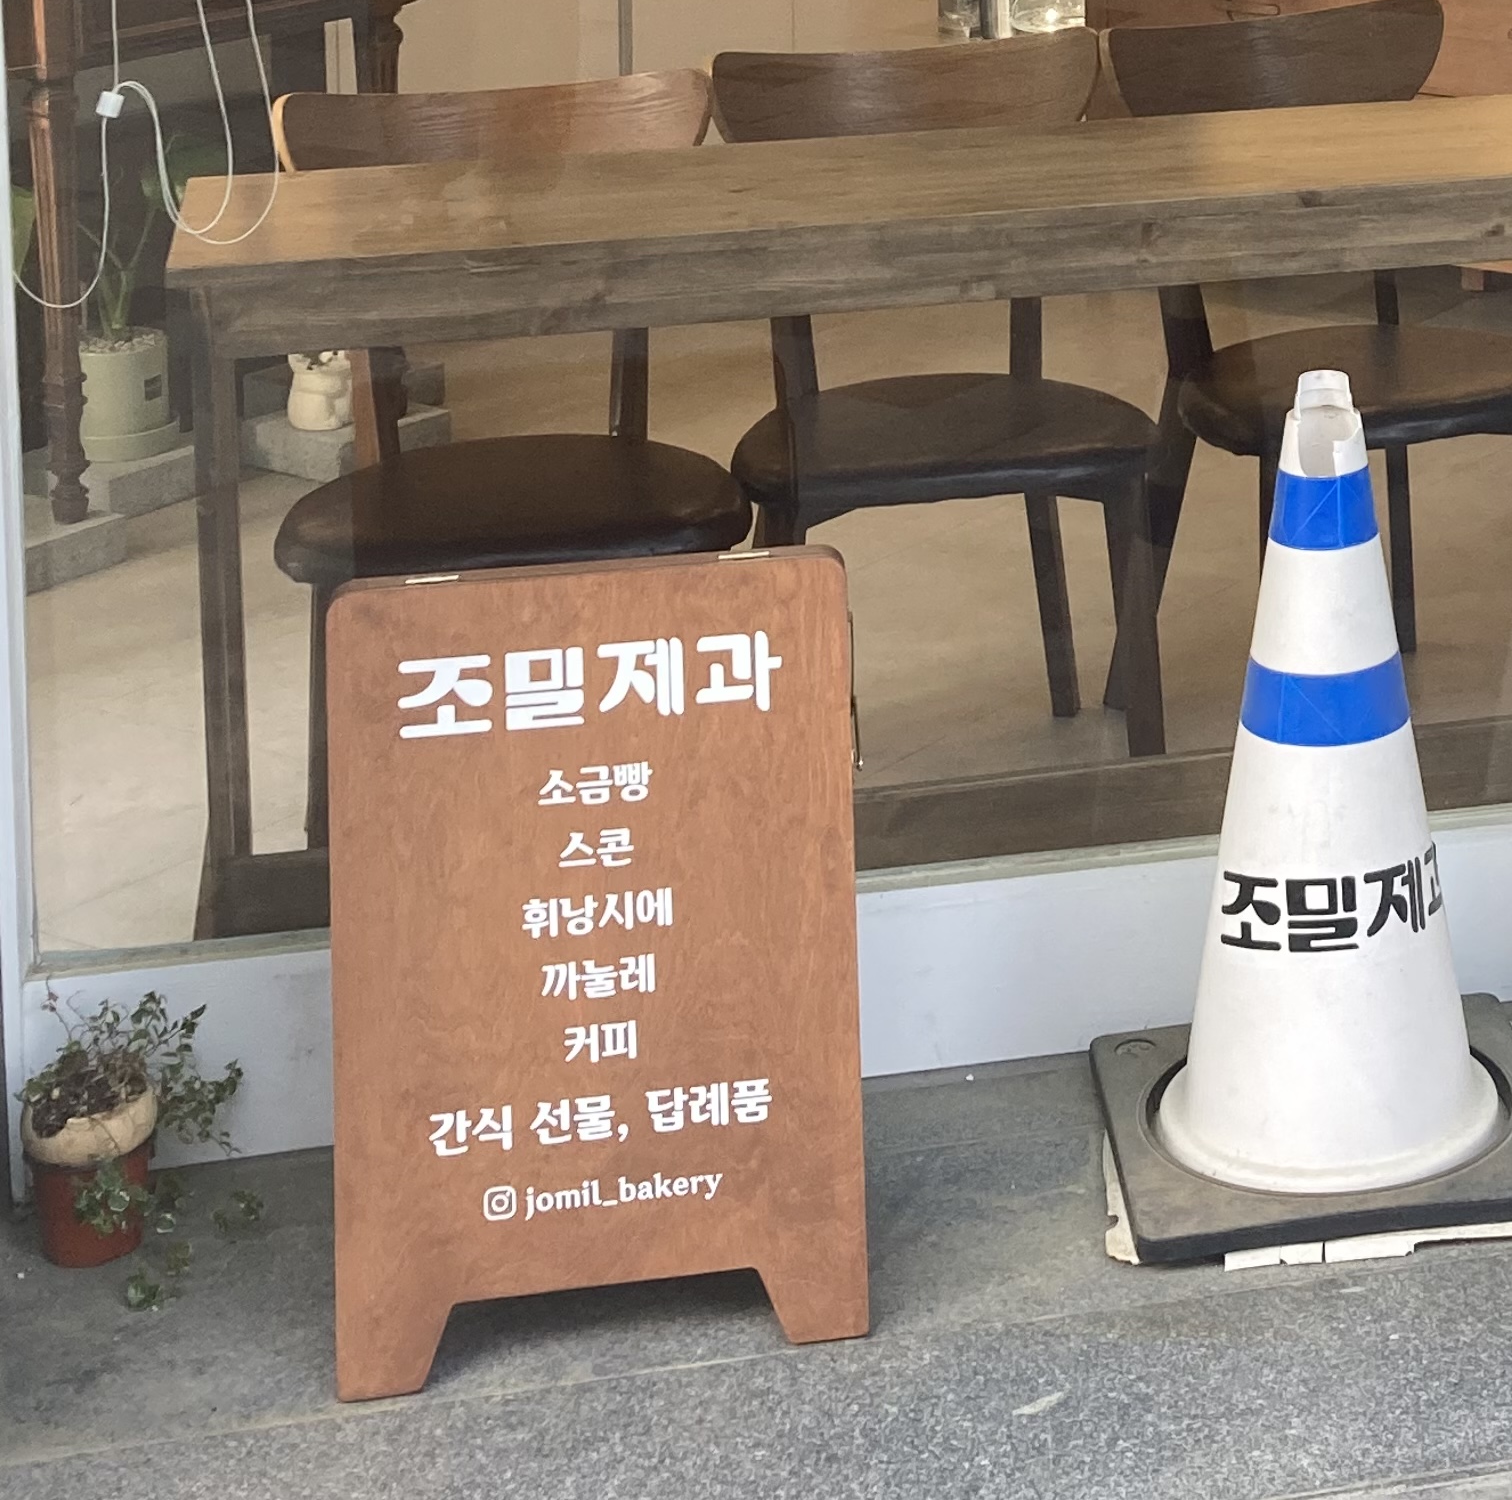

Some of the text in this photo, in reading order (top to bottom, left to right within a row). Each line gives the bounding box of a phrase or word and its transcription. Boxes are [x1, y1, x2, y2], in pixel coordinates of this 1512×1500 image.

[397, 630, 783, 739] 조밀제과
[537, 761, 654, 806] 소금빵
[558, 827, 635, 868] 스콘
[521, 887, 673, 939] 휘낭시에
[541, 953, 656, 1000] 까눌레
[563, 1020, 638, 1063] 커피
[428, 1078, 772, 1157] 간식 선물, 답례품
[524, 1171, 723, 1220] jomil_bakery
